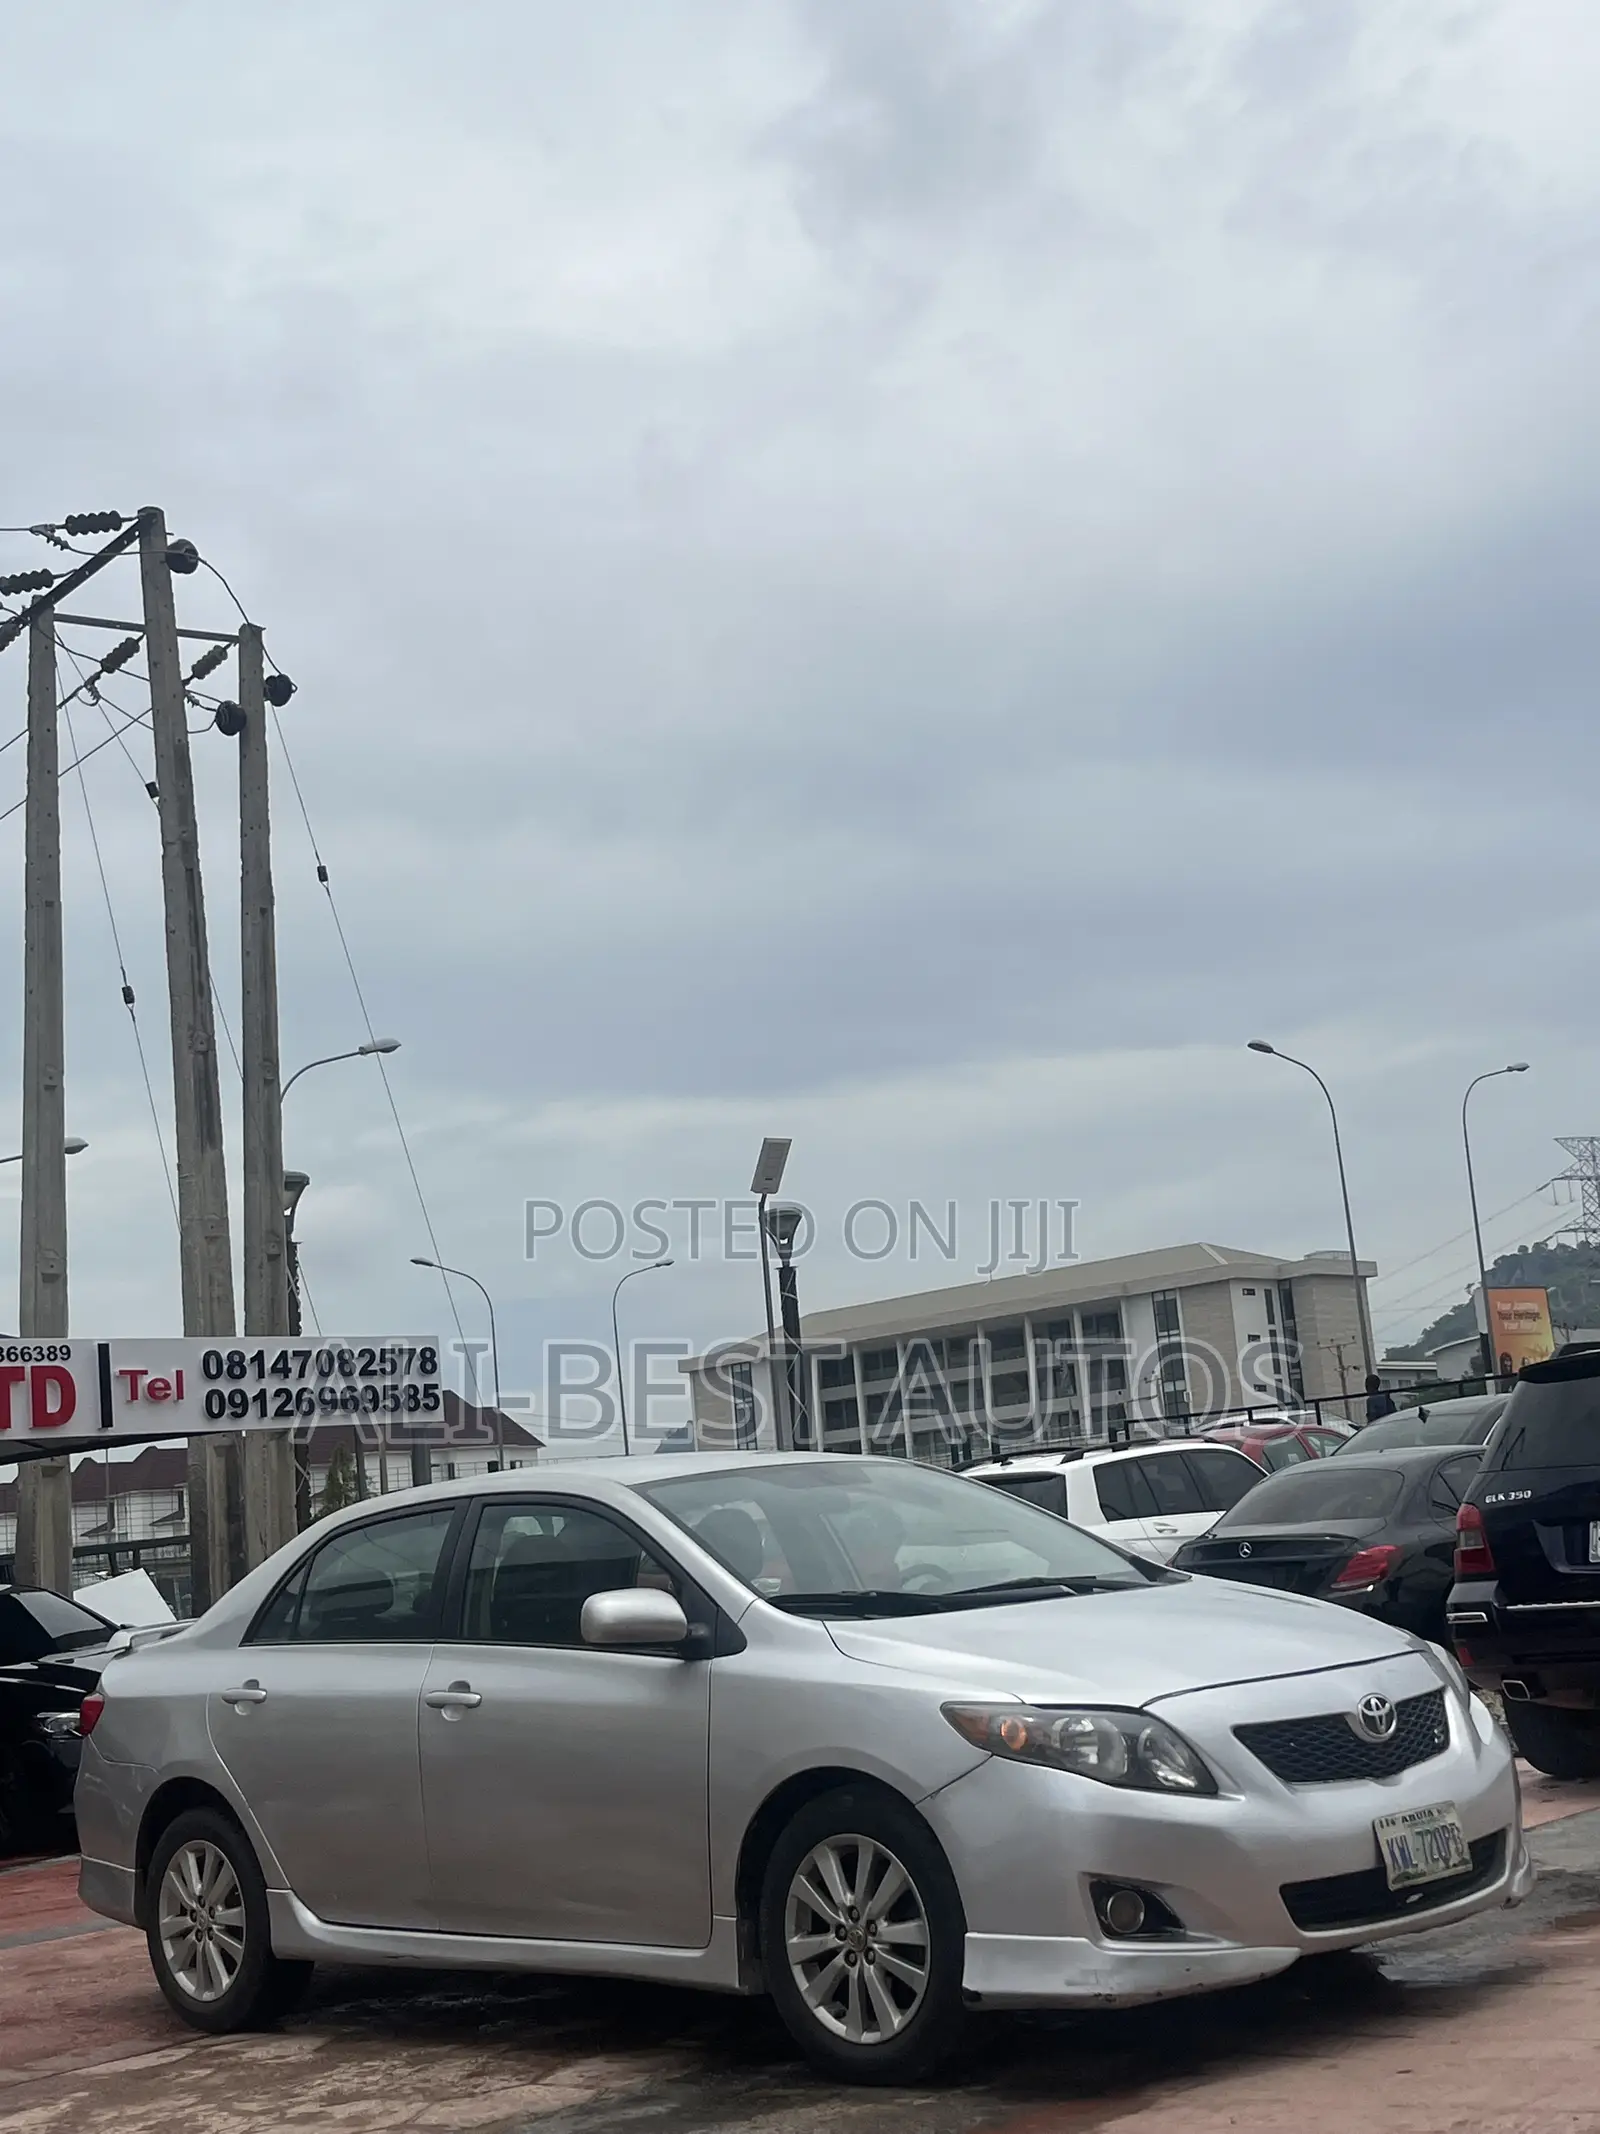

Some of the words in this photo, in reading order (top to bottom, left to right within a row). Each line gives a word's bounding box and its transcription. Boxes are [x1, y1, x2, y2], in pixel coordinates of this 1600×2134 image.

[202, 1347, 438, 1380] 08147082578
[118, 1369, 184, 1401] Tel
[205, 1384, 441, 1419] 09126969585
[1485, 1493, 1505, 1503] GLK
[1508, 1490, 1532, 1500] 350
